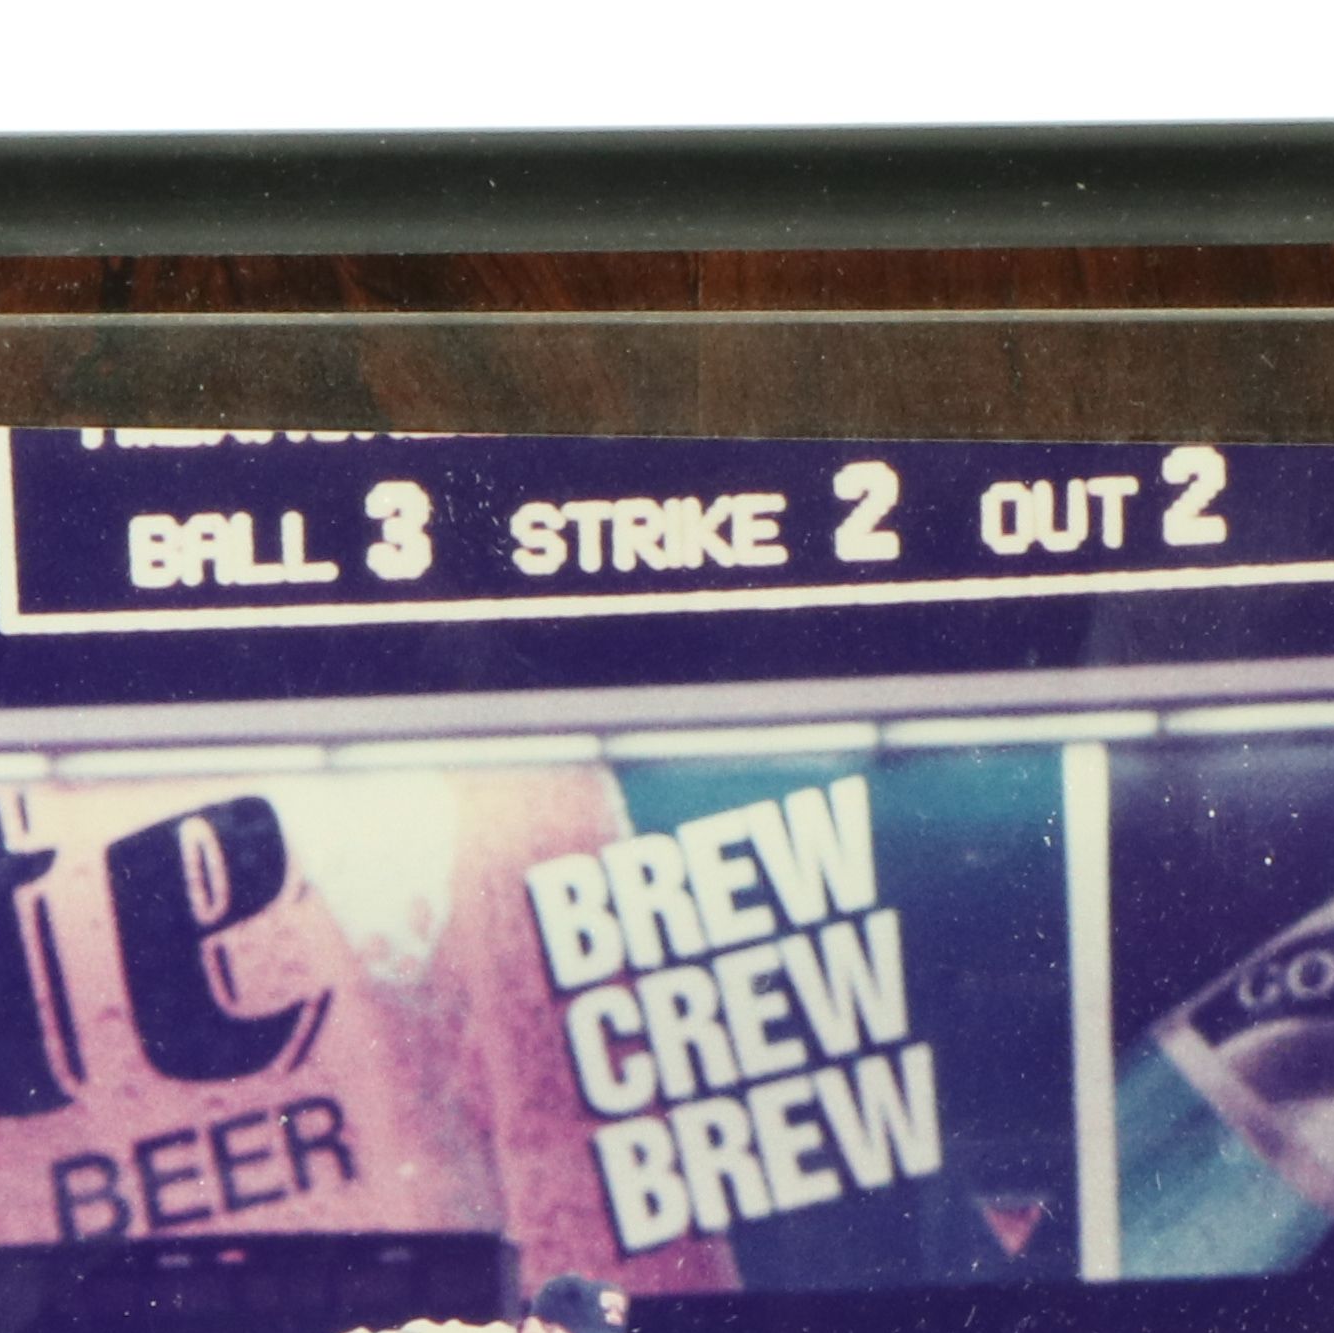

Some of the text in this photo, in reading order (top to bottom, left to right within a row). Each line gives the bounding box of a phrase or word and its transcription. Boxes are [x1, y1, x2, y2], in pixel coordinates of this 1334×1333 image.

[128, 446, 1228, 588] BALL 3 STRIKE 2 OUT 2
[525, 774, 878, 991] BREW
[565, 908, 910, 1117] CREW
[51, 1095, 359, 1242] BEER
[591, 1041, 943, 1253] BREW
